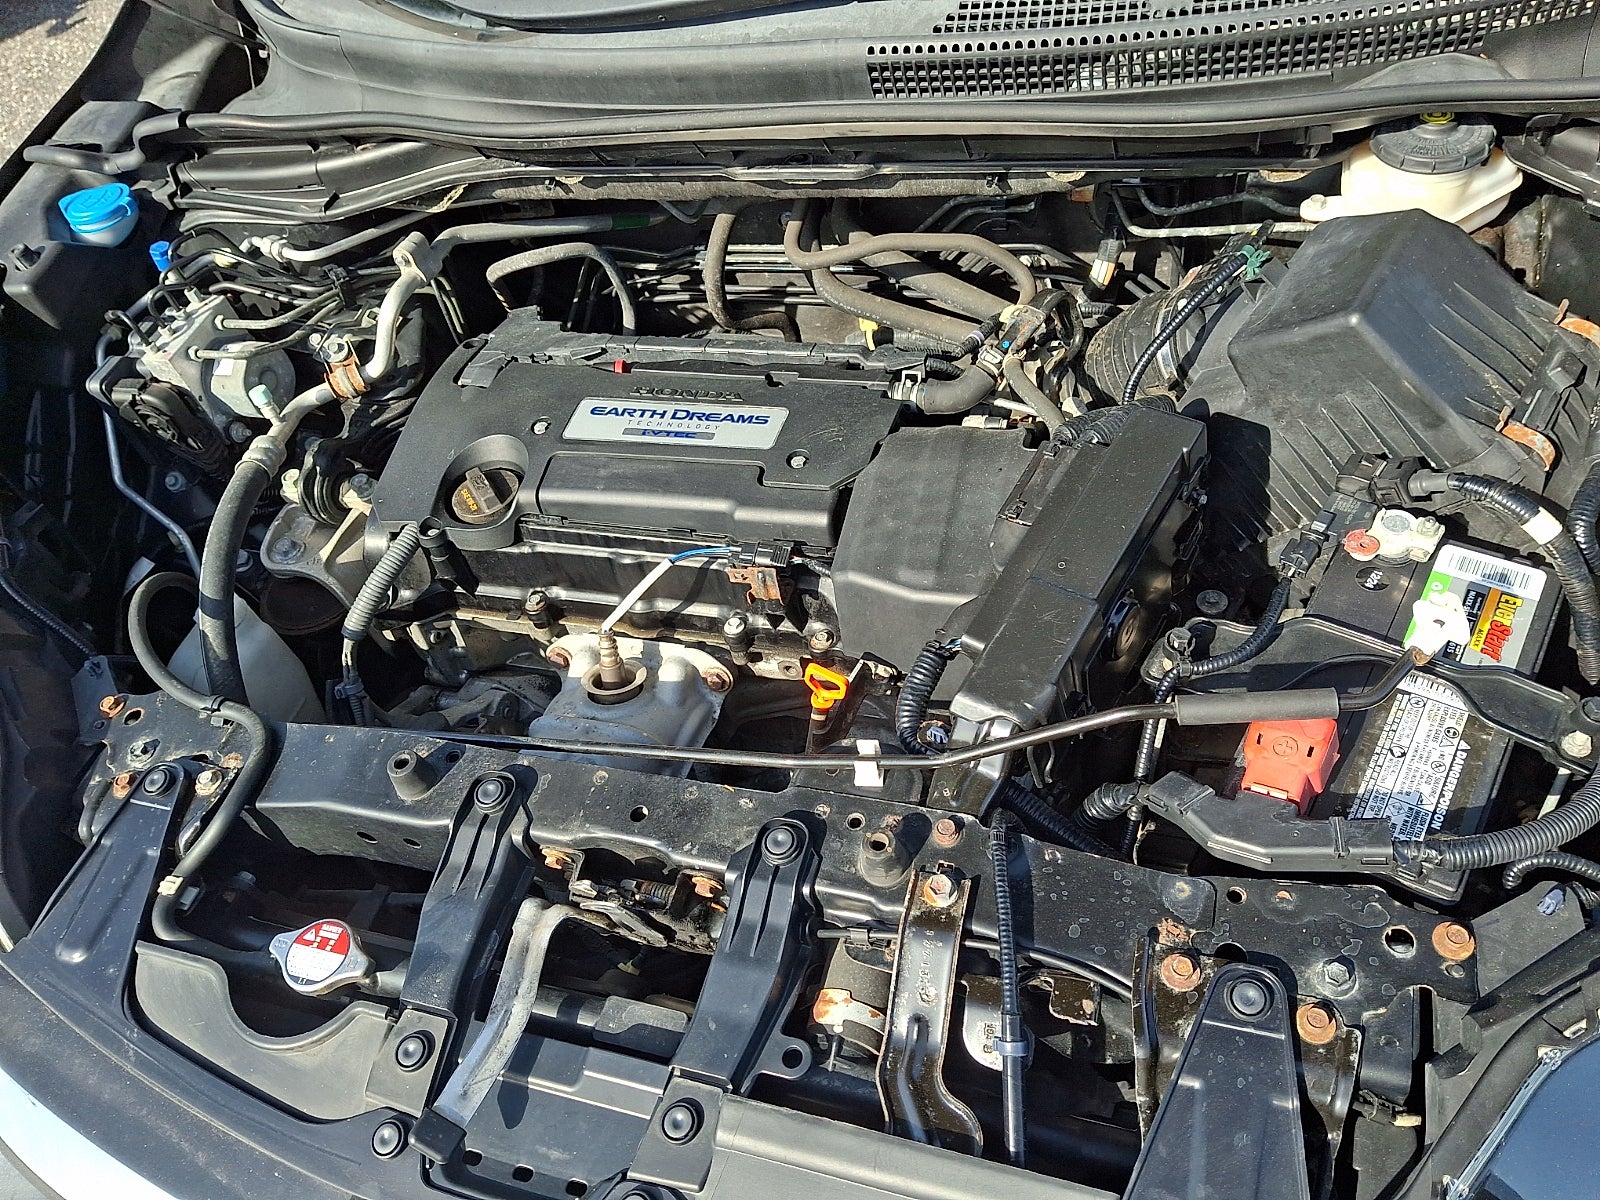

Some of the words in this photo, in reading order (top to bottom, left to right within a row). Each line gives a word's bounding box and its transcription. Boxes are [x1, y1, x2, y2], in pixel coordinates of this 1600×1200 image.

[629, 386, 744, 401] HONDA
[590, 406, 668, 419] EARTH
[671, 409, 770, 425] DREAMS
[628, 420, 720, 430] TECHNOLOGY
[1482, 594, 1523, 663] EverStart
[1474, 629, 1484, 647] MAXX
[1446, 642, 1456, 653] 615
[1430, 750, 1466, 829] DANGER/POISON
